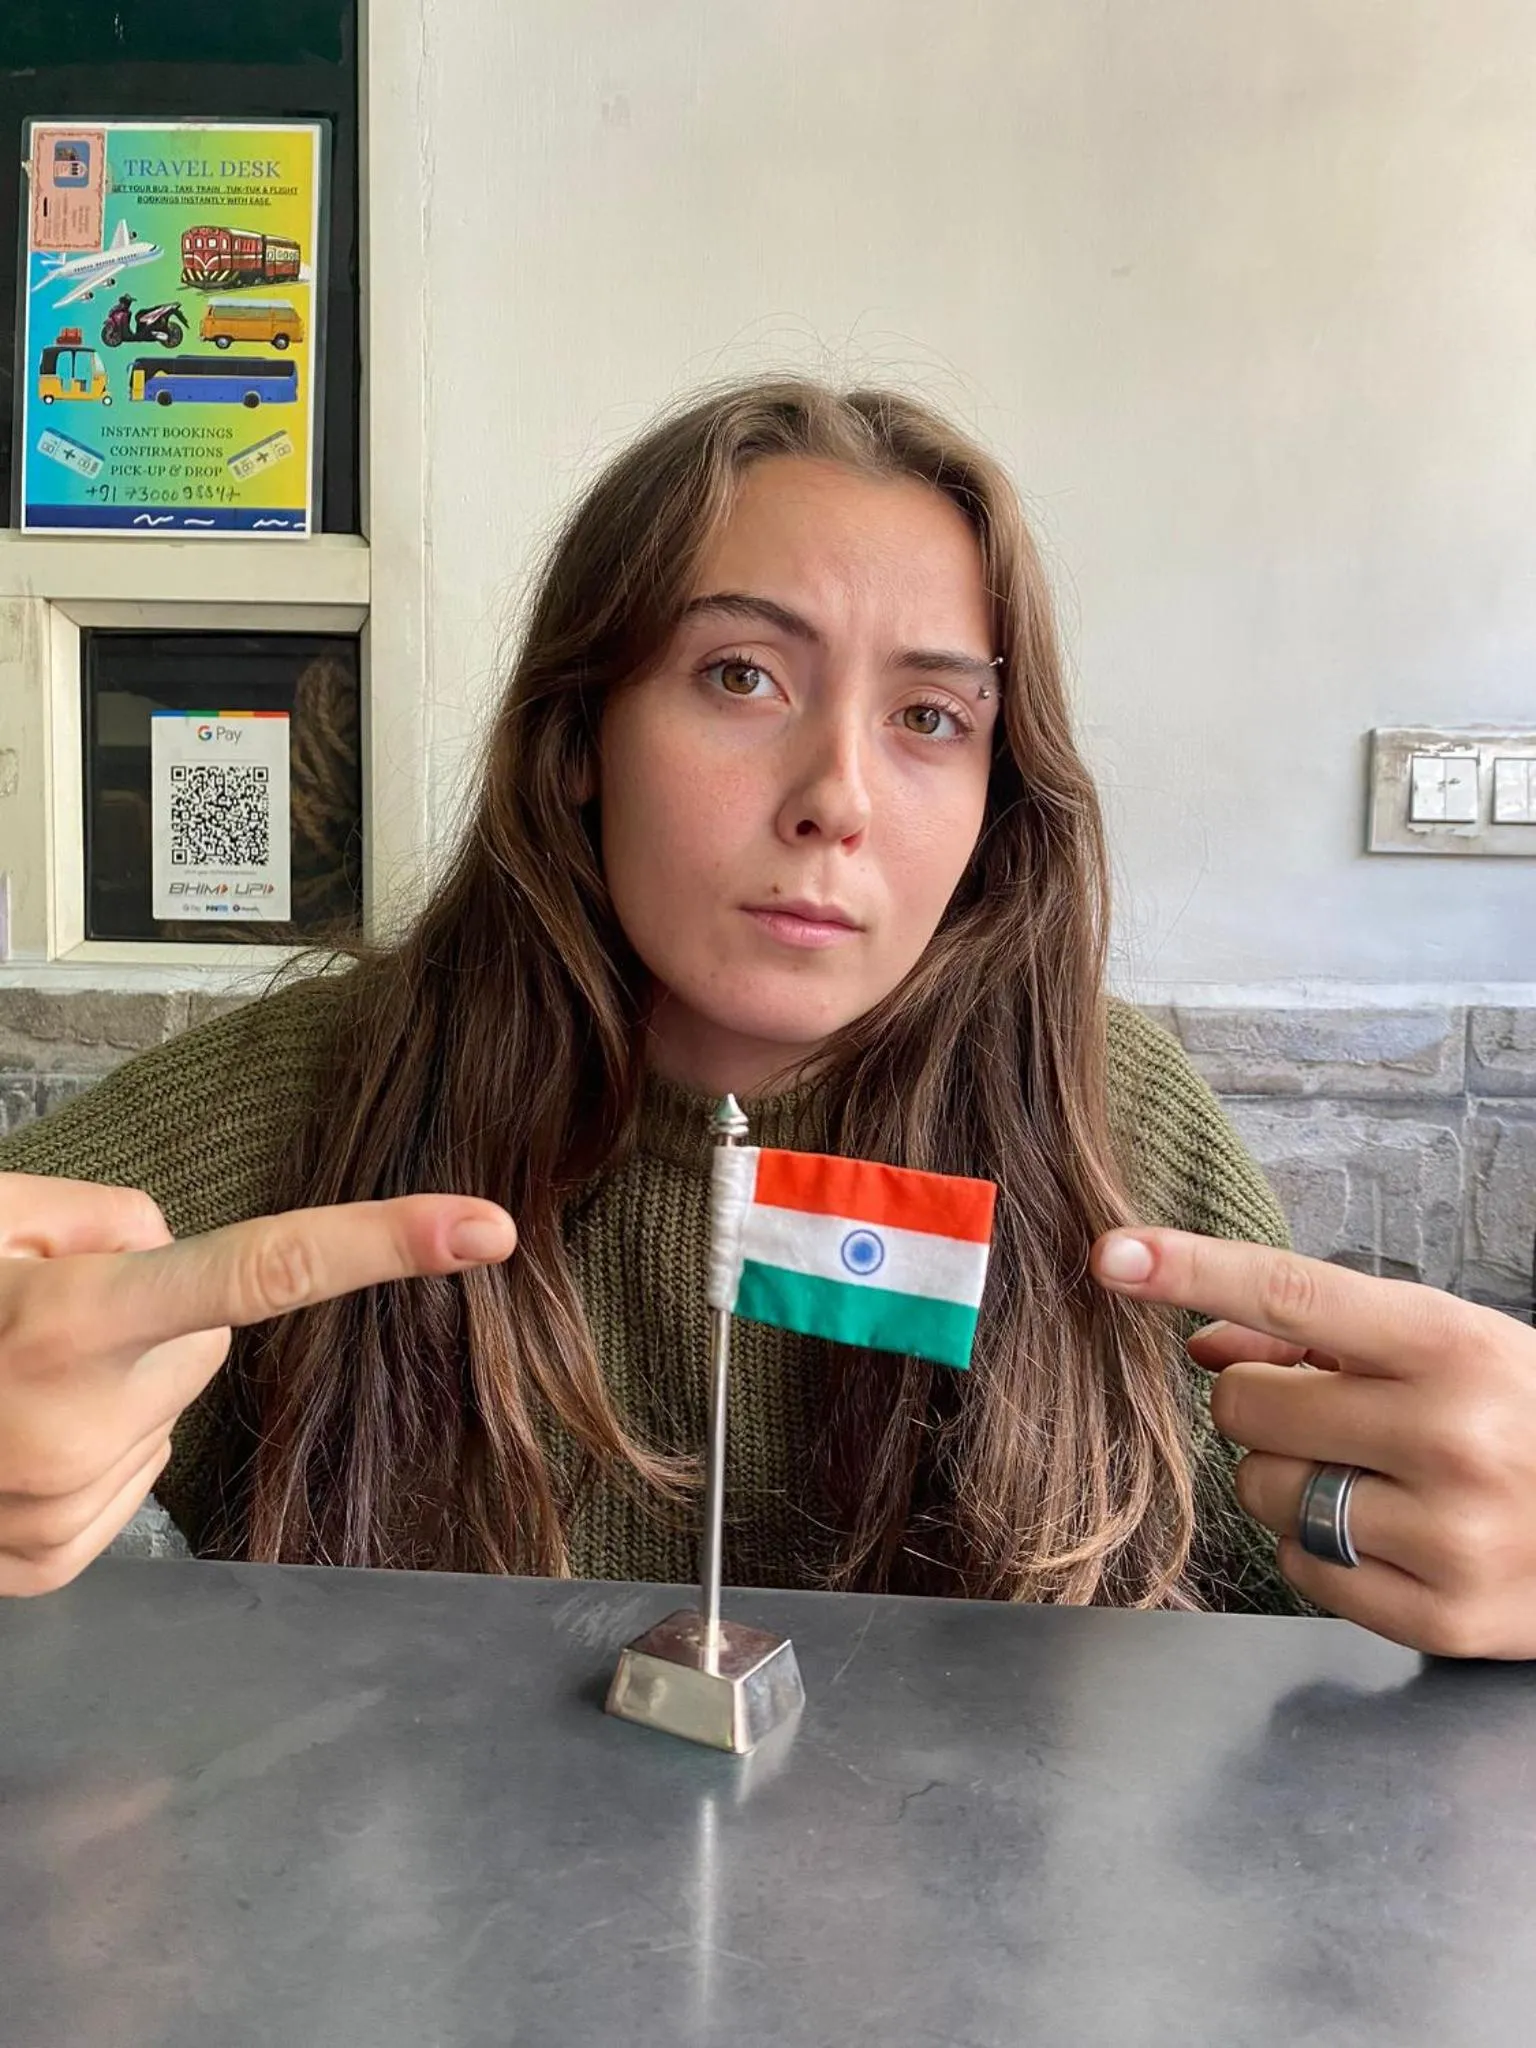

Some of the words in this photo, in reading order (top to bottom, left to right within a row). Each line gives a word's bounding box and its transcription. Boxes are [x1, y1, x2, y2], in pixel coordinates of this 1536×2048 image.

[124, 159, 213, 178] TRAVEL
[220, 160, 281, 178] DESK
[128, 185, 151, 194] YOUR
[226, 186, 260, 195] TUK-TUK
[269, 186, 298, 196] FLIGHT
[137, 195, 179, 205] BOOKINGS
[180, 196, 225, 206] INSTANTLY
[226, 197, 248, 206] WITH
[101, 426, 158, 438] INSTANT
[163, 427, 234, 439] BOOKINGS
[110, 445, 224, 459] CONFIRMATIONS
[110, 464, 166, 477] PICK-UP
[169, 466, 183, 477] &
[185, 466, 223, 478] DROP
[85, 484, 117, 503] +91
[216, 726, 243, 745] Pay
